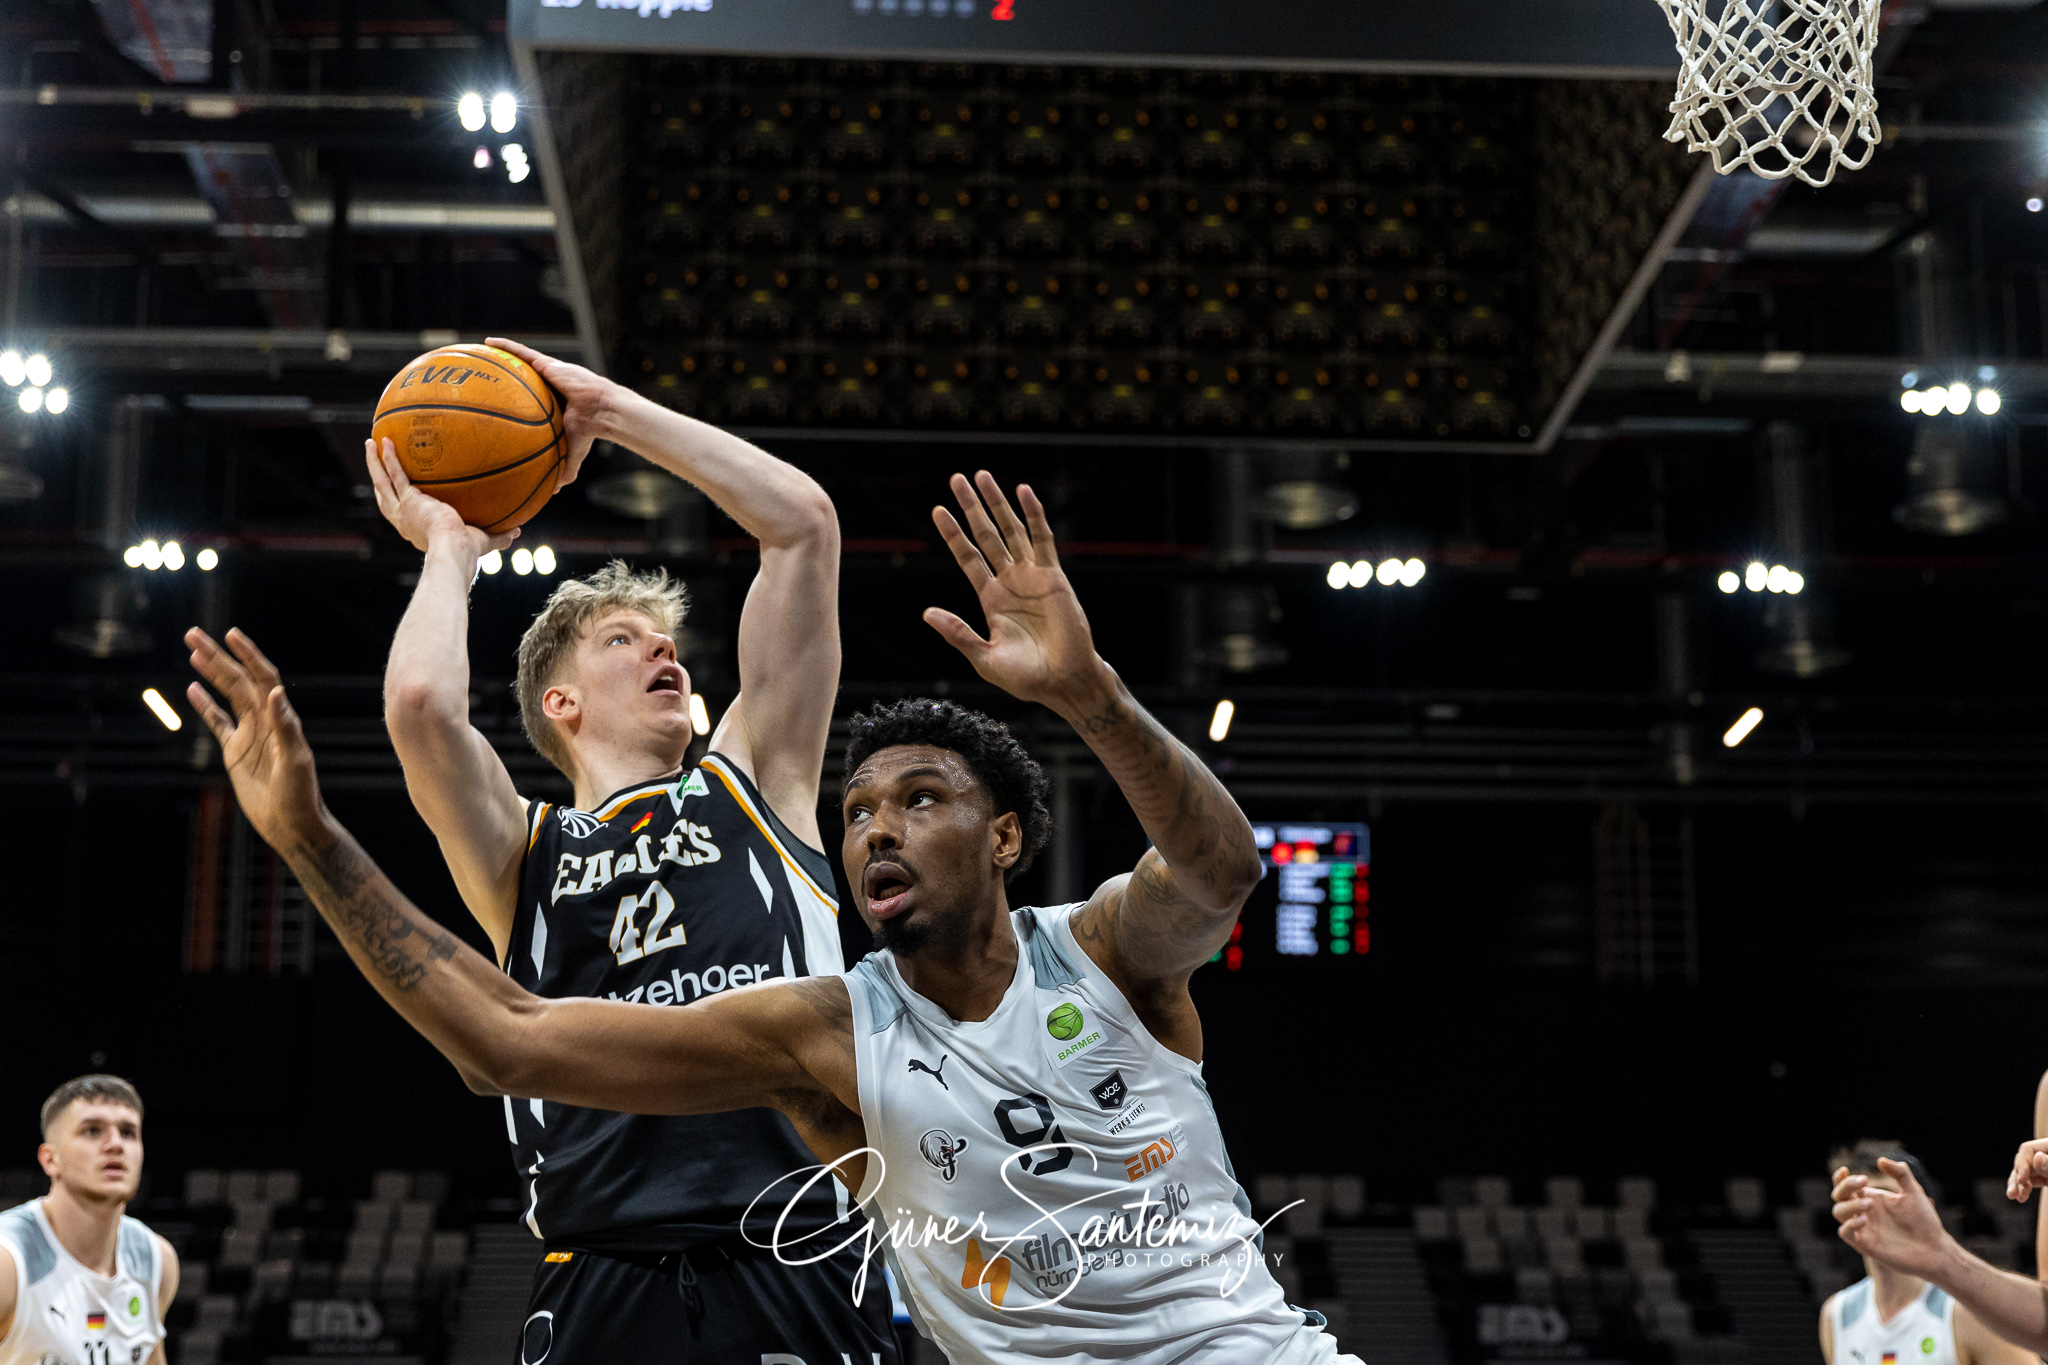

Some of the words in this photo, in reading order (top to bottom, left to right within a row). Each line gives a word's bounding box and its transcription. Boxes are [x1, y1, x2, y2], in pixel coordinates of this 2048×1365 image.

[400, 365, 475, 389] EVO
[474, 371, 501, 384] NXT
[608, 880, 687, 966] 42
[1058, 1031, 1101, 1061] BARMER
[1128, 1103, 1146, 1121] EVENTS
[993, 1092, 1074, 1176] 9
[1123, 1136, 1175, 1183] EMS
